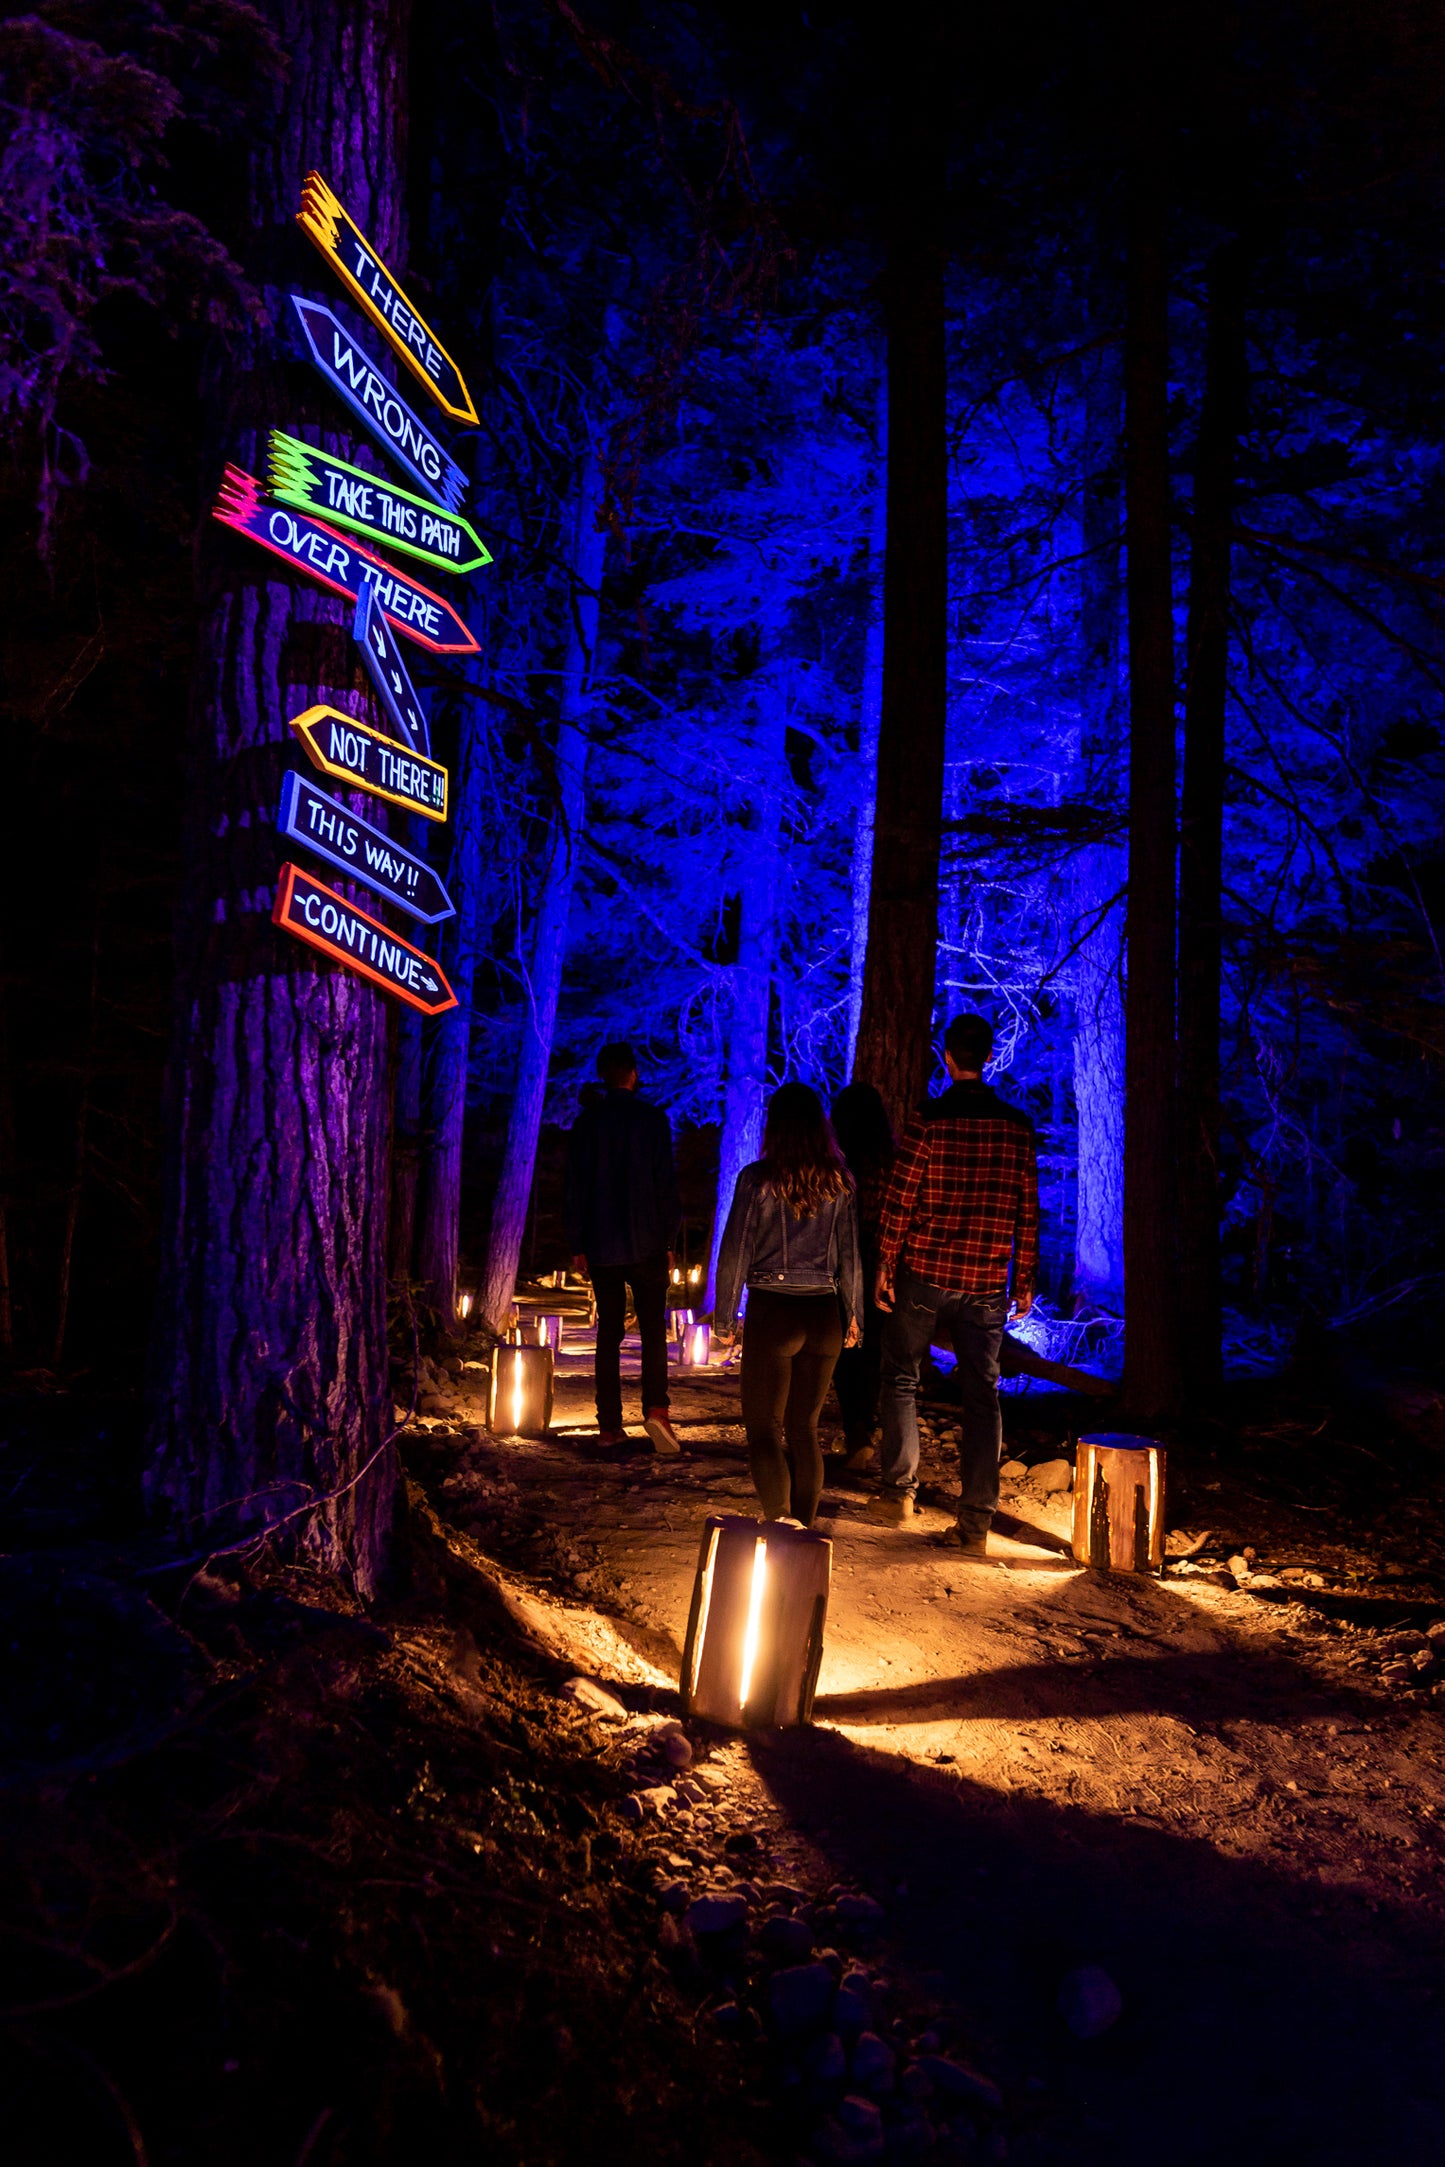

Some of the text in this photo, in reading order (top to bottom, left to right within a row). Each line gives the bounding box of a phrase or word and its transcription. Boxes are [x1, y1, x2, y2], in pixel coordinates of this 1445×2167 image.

[354, 242, 443, 379] THERE
[333, 332, 441, 480] WRONG
[325, 470, 460, 557] TAKE THIS PATH
[269, 511, 444, 635] OVER THERE
[329, 723, 371, 772] NOT
[307, 799, 358, 855] THIS
